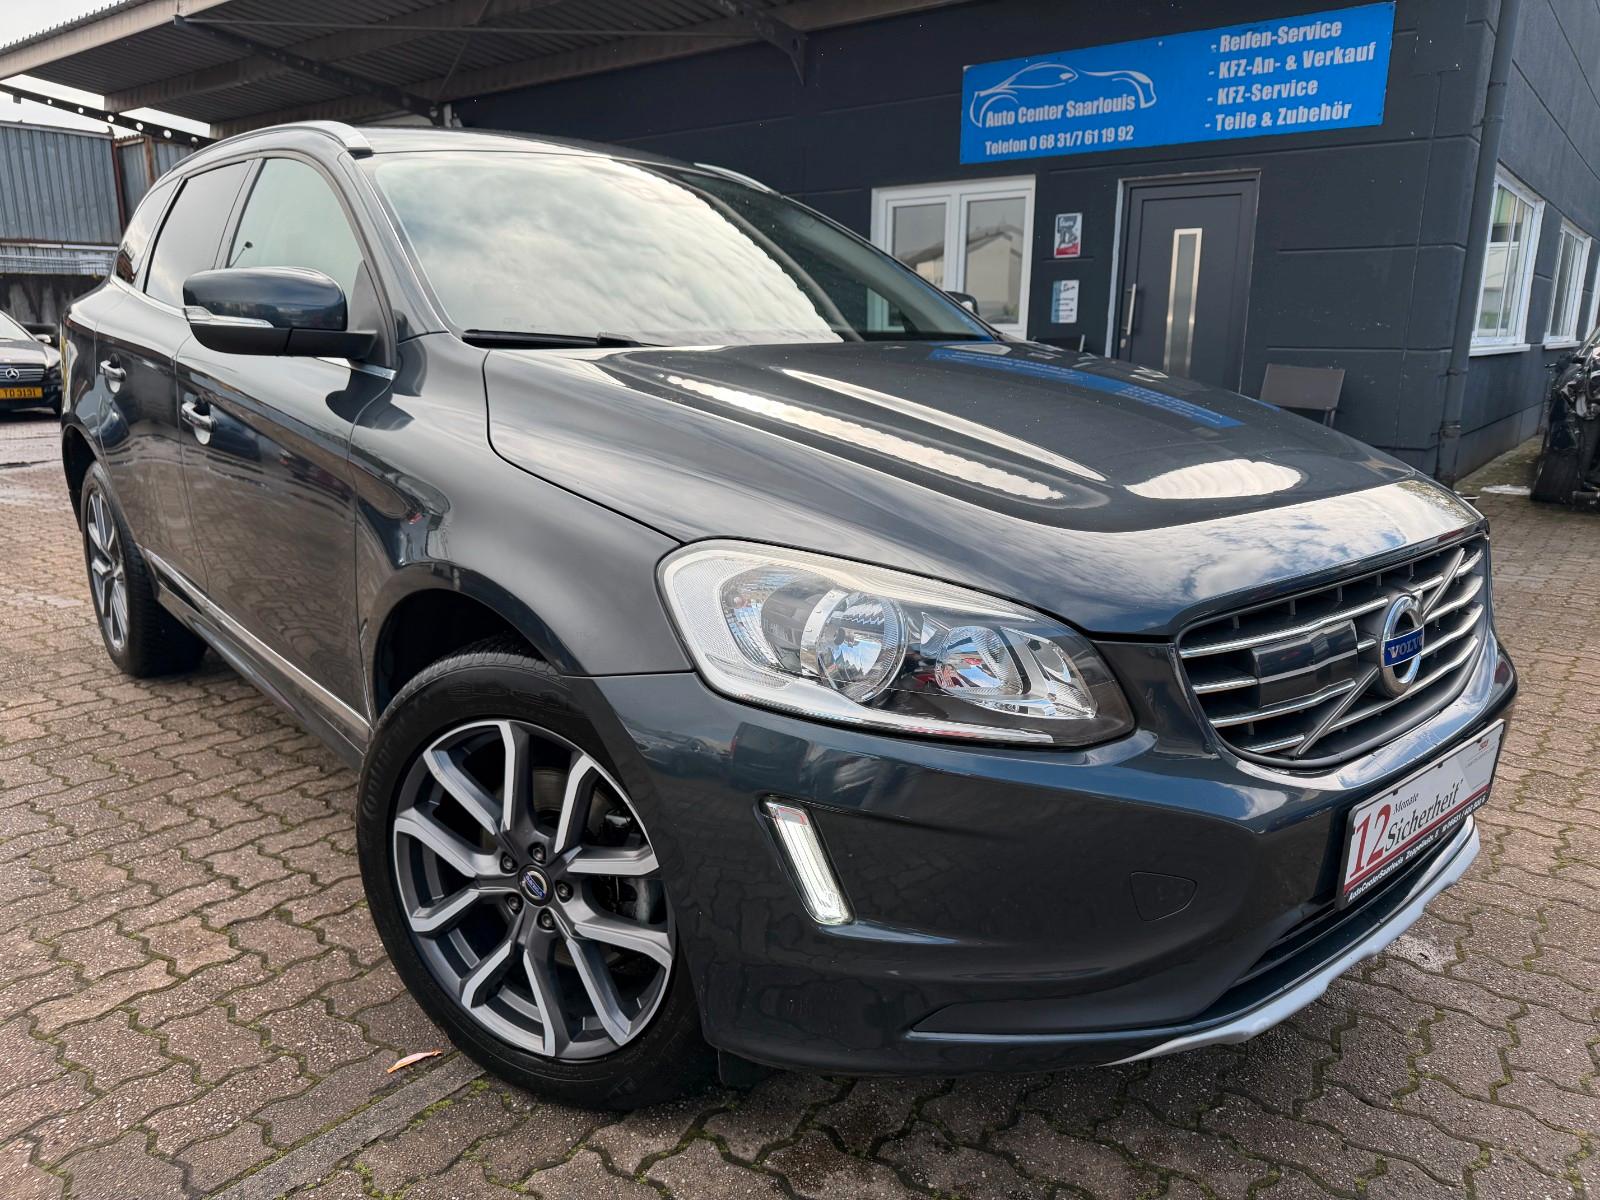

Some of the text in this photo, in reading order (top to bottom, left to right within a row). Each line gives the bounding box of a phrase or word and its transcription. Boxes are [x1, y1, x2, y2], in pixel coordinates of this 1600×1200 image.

[1220, 21, 1342, 53] Reifen-Service
[1218, 57, 1281, 80] KFZ-An-
[1285, 55, 1297, 71] &
[1302, 42, 1377, 69] Verkauf
[1217, 80, 1319, 106] KFZ-Service
[985, 94, 1136, 128] Auto Center Saarlouis
[1215, 111, 1257, 132] Teile
[1261, 111, 1273, 128] &
[1276, 101, 1352, 126] Zubehör
[985, 137, 1027, 156] Telefon
[1029, 136, 1037, 150] 0
[1039, 134, 1055, 149] 68
[1057, 130, 1083, 148] 31/7
[1101, 127, 1115, 143] 19
[1118, 125, 1135, 141] 92
[1388, 635, 1423, 659] VOLVO
[1350, 804, 1391, 878] 12
